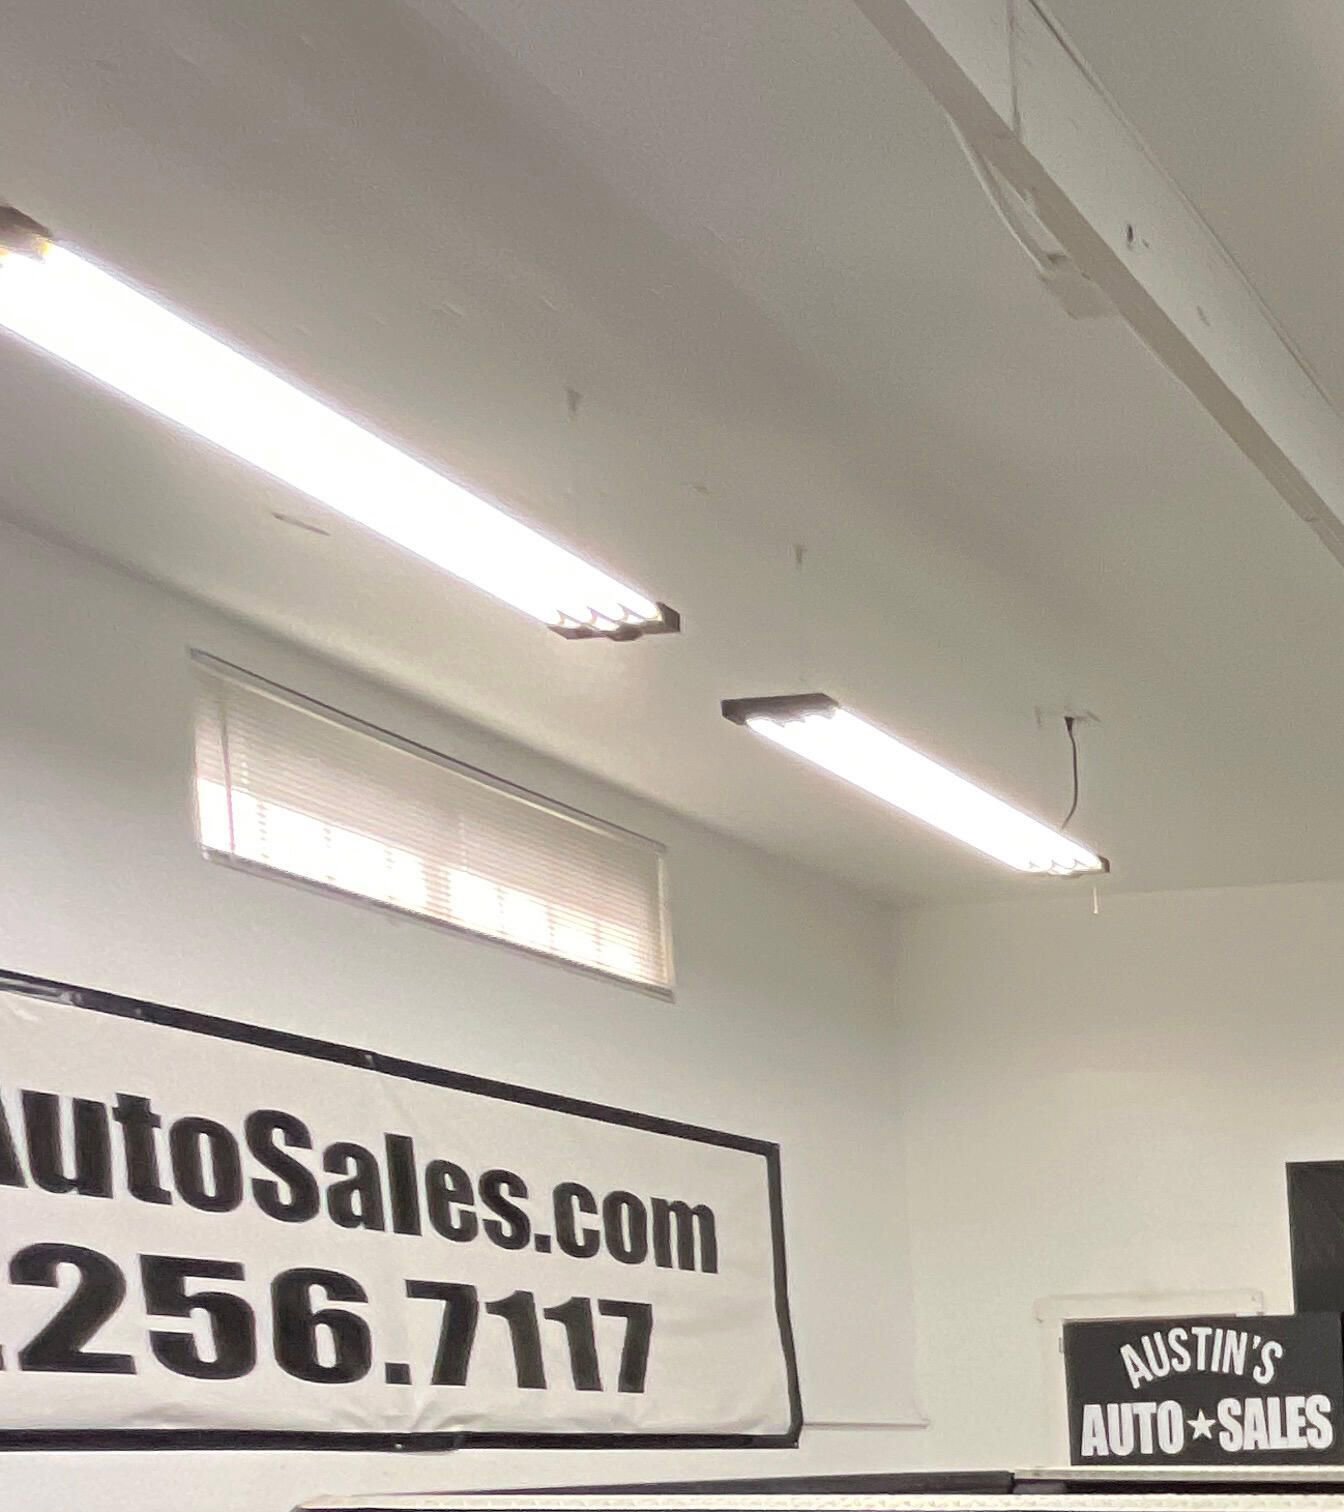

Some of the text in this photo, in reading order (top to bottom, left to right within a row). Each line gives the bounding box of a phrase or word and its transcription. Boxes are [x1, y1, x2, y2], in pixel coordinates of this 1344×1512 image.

[0, 1242, 654, 1394] 256.7117
[1120, 1326, 1284, 1389] AUSTIN'S
[1081, 1394, 1334, 1457] AUTO SALES
